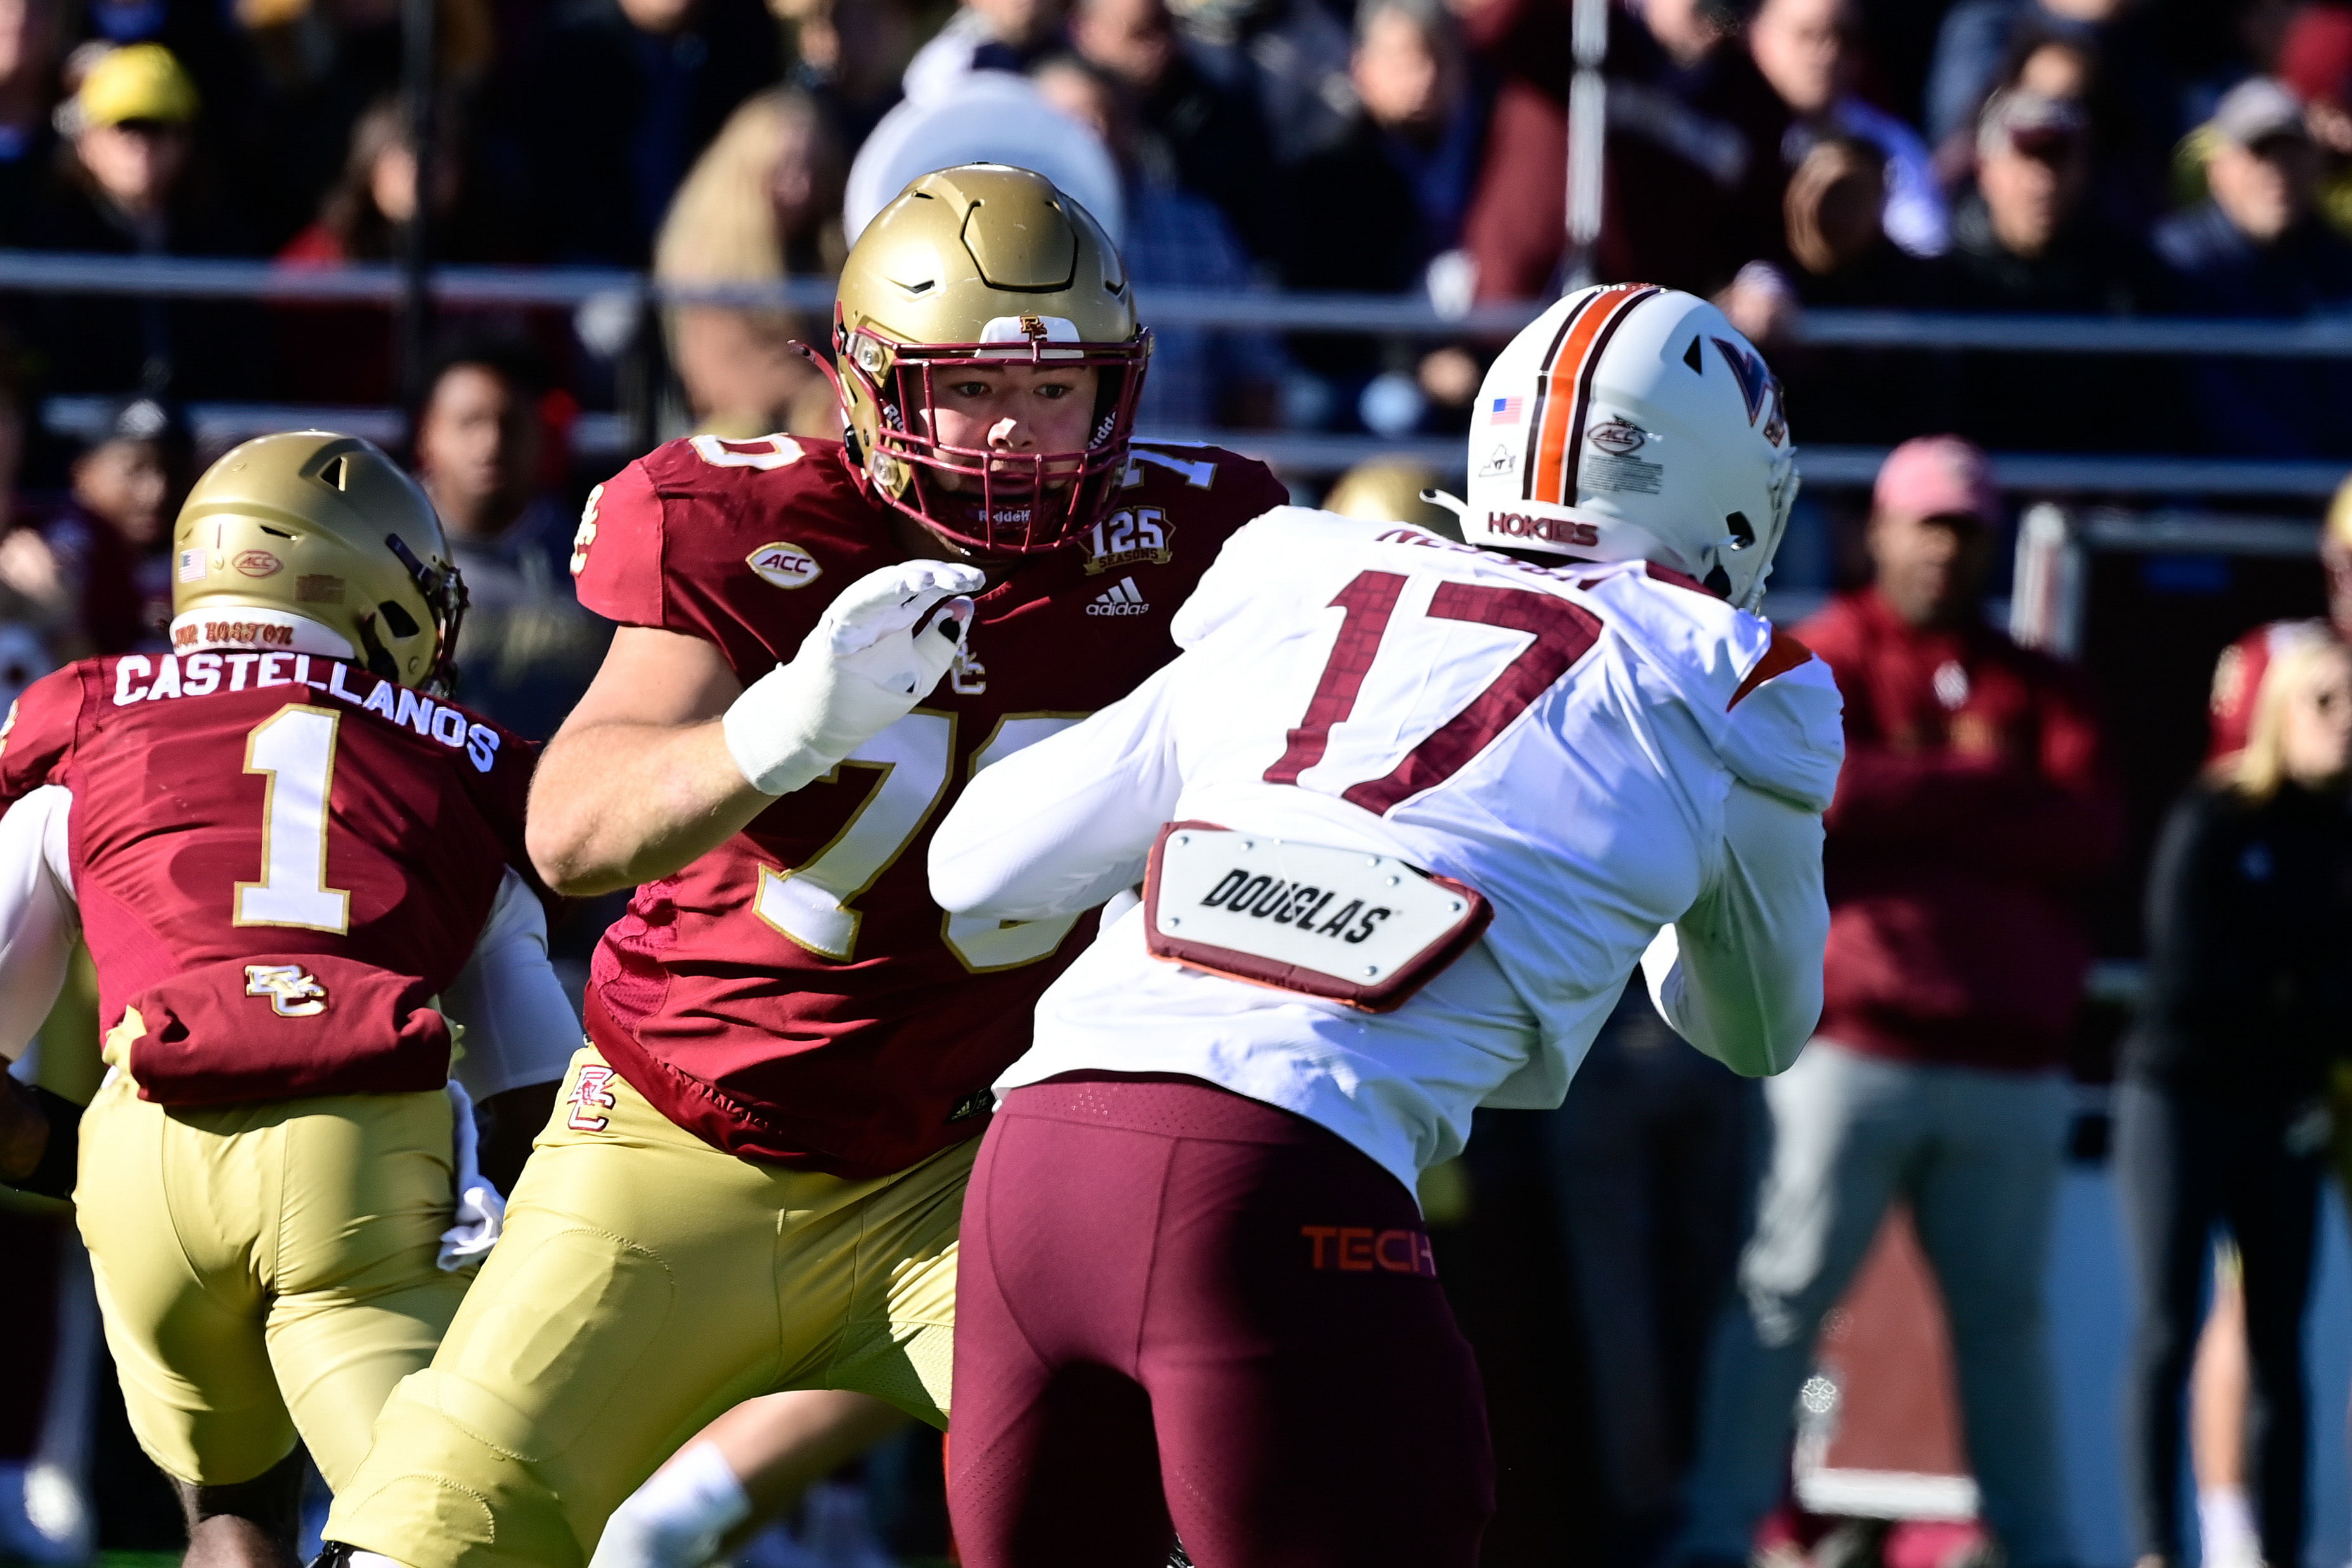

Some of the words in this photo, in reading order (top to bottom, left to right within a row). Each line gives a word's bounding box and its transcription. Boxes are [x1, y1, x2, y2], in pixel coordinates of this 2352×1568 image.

[1087, 411, 1116, 449] Ridd
[978, 510, 1031, 524] Rddell
[1090, 509, 1165, 559] 125
[1488, 511, 1600, 547] HOKIES
[242, 556, 271, 568] ACC
[761, 553, 812, 574] ACC
[1099, 549, 1159, 568] SEASONS
[1086, 602, 1149, 617] adidas
[204, 621, 294, 646] BOSTON
[113, 651, 501, 773] CASTELLANOS
[1262, 569, 1605, 818] 17
[232, 702, 351, 937] 1
[1199, 867, 1392, 944] DOUGLAS
[1301, 1225, 1437, 1276] TECH
